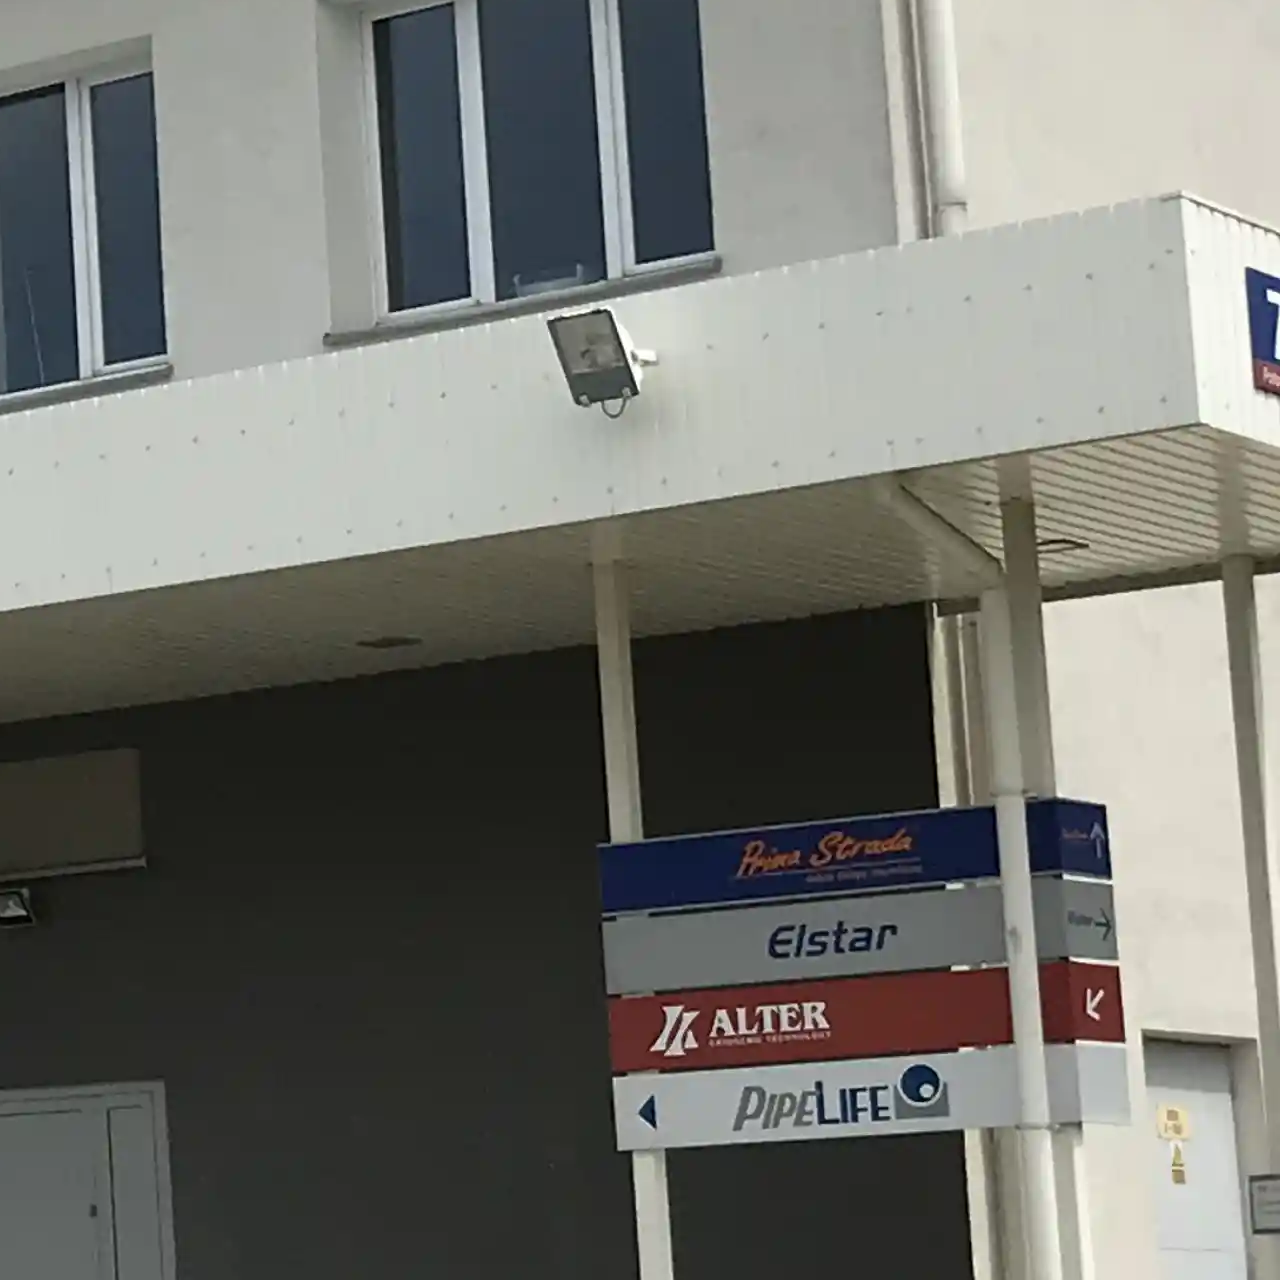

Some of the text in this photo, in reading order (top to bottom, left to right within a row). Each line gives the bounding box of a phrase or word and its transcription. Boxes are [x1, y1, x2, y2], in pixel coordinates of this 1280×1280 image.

[809, 827, 913, 868] Strada
[768, 920, 899, 960] Elstar
[708, 1001, 831, 1039] ALTER
